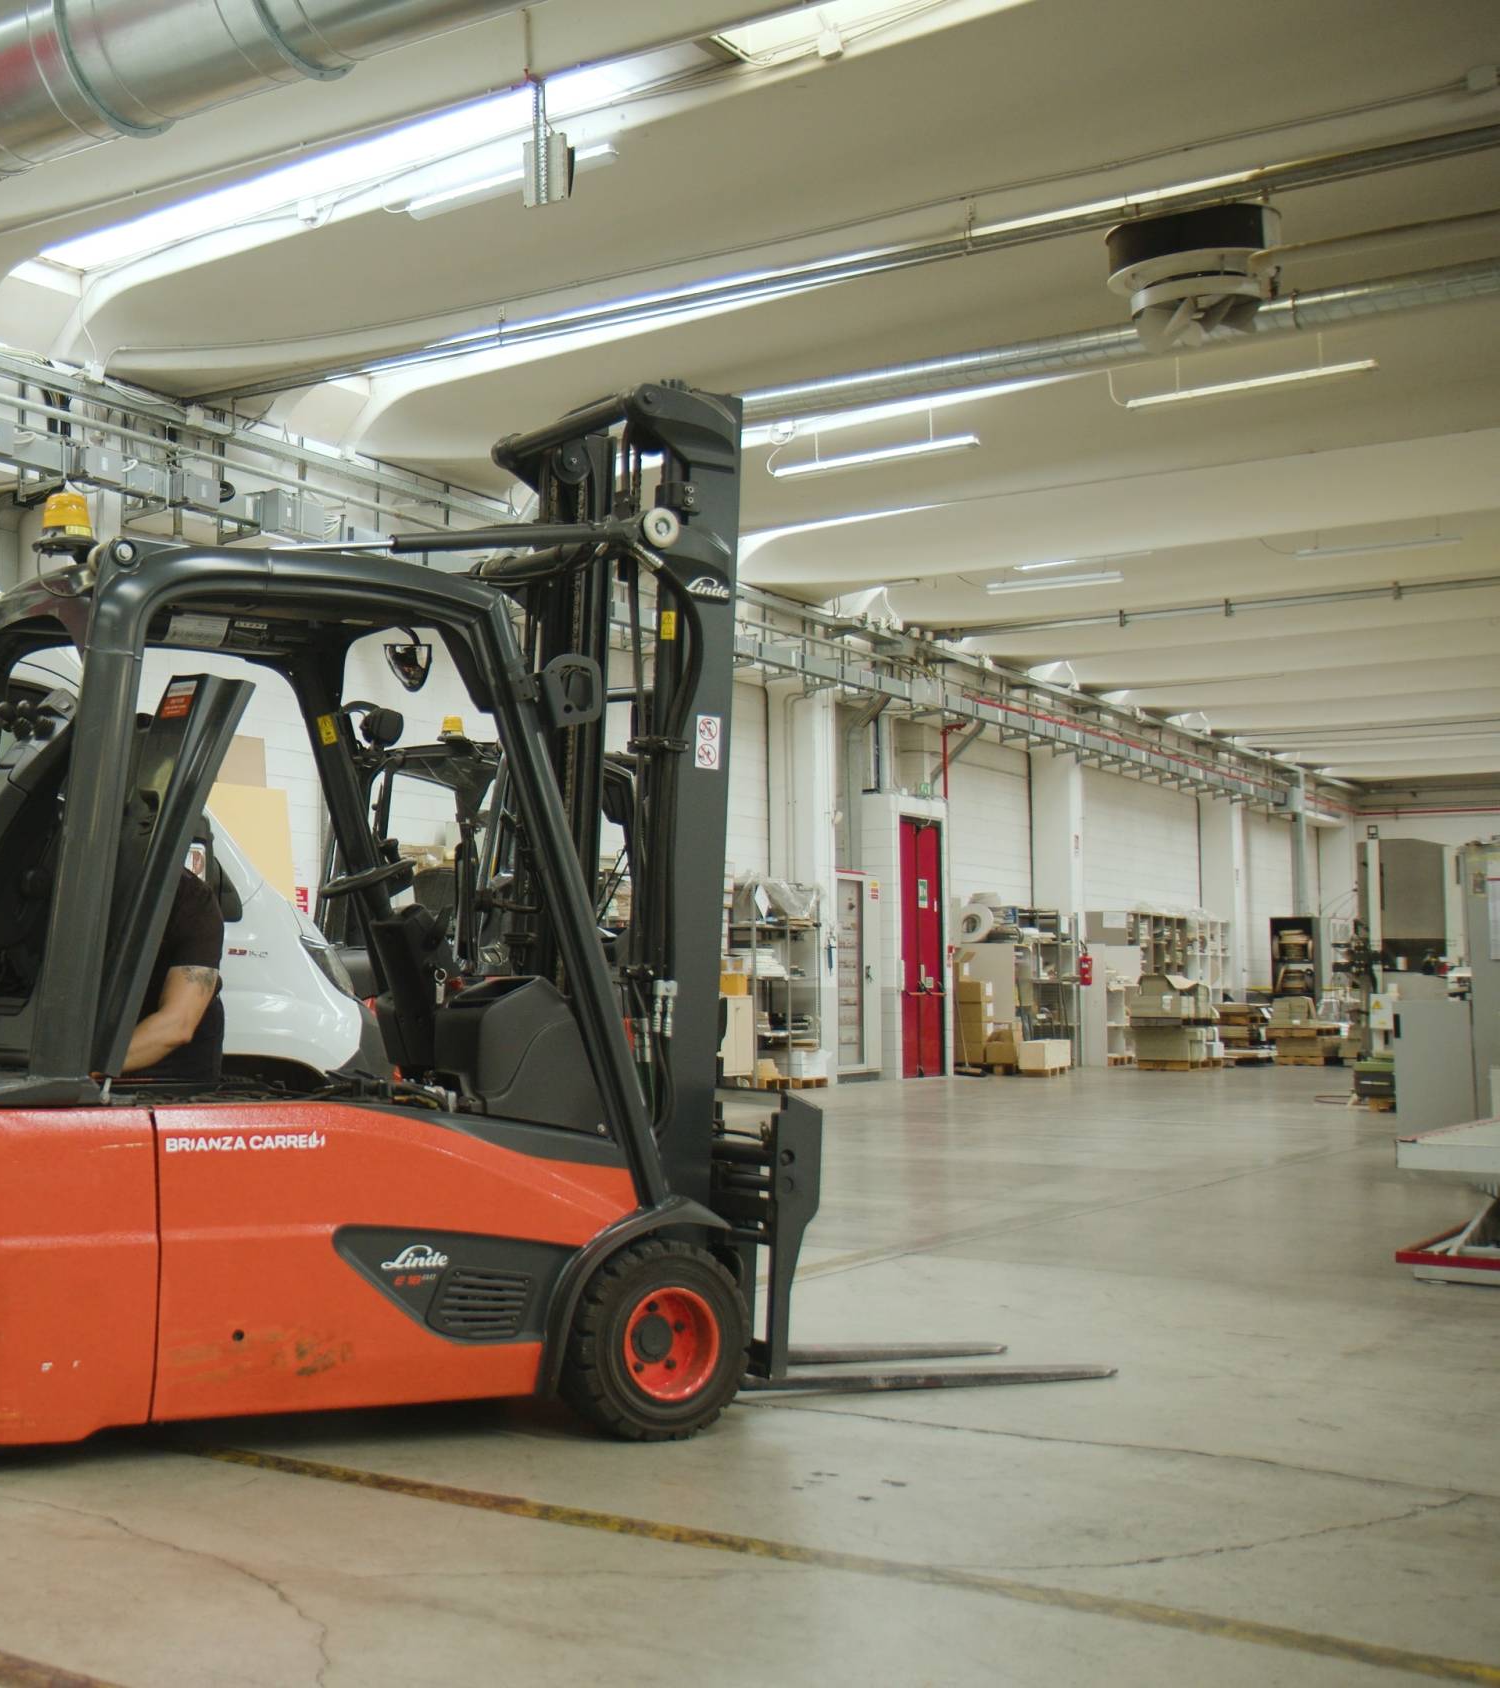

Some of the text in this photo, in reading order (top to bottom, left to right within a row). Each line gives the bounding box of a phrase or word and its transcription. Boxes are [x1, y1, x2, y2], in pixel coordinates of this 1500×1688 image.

[684, 576, 730, 598] Linde
[165, 1136, 246, 1152] BRIANZA
[380, 1244, 449, 1270] Linde
